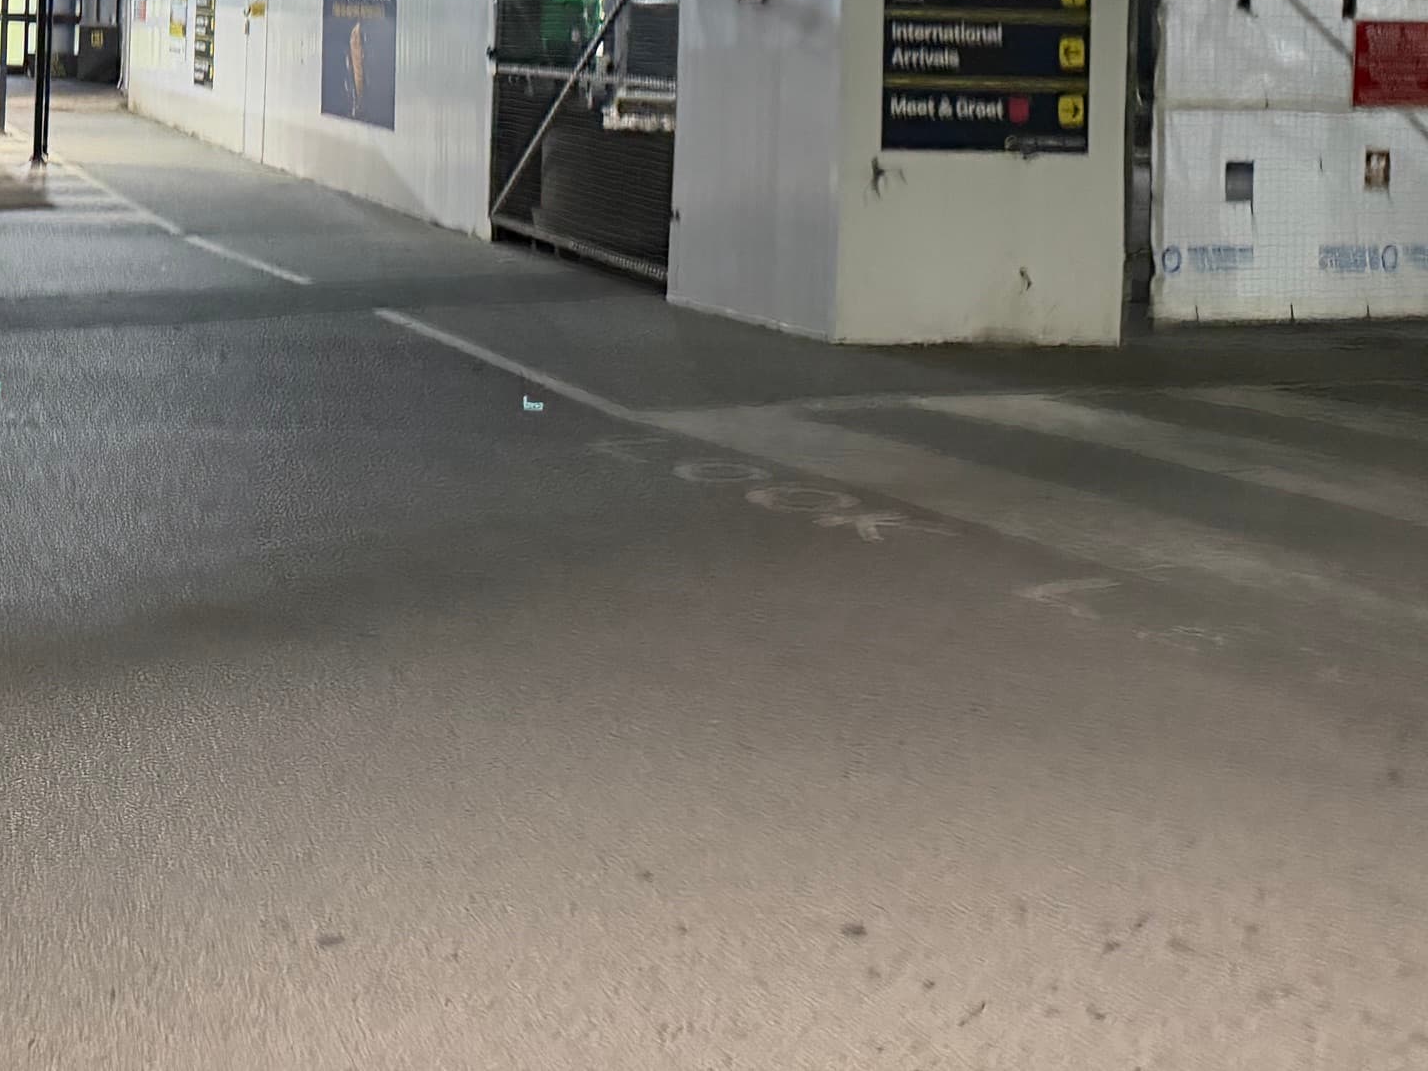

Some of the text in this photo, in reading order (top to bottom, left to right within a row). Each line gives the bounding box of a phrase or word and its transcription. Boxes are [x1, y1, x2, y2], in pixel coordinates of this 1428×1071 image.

[892, 20, 1003, 47] International
[891, 46, 960, 71] Arrivals
[890, 93, 935, 120] Meet
[937, 94, 953, 120] &
